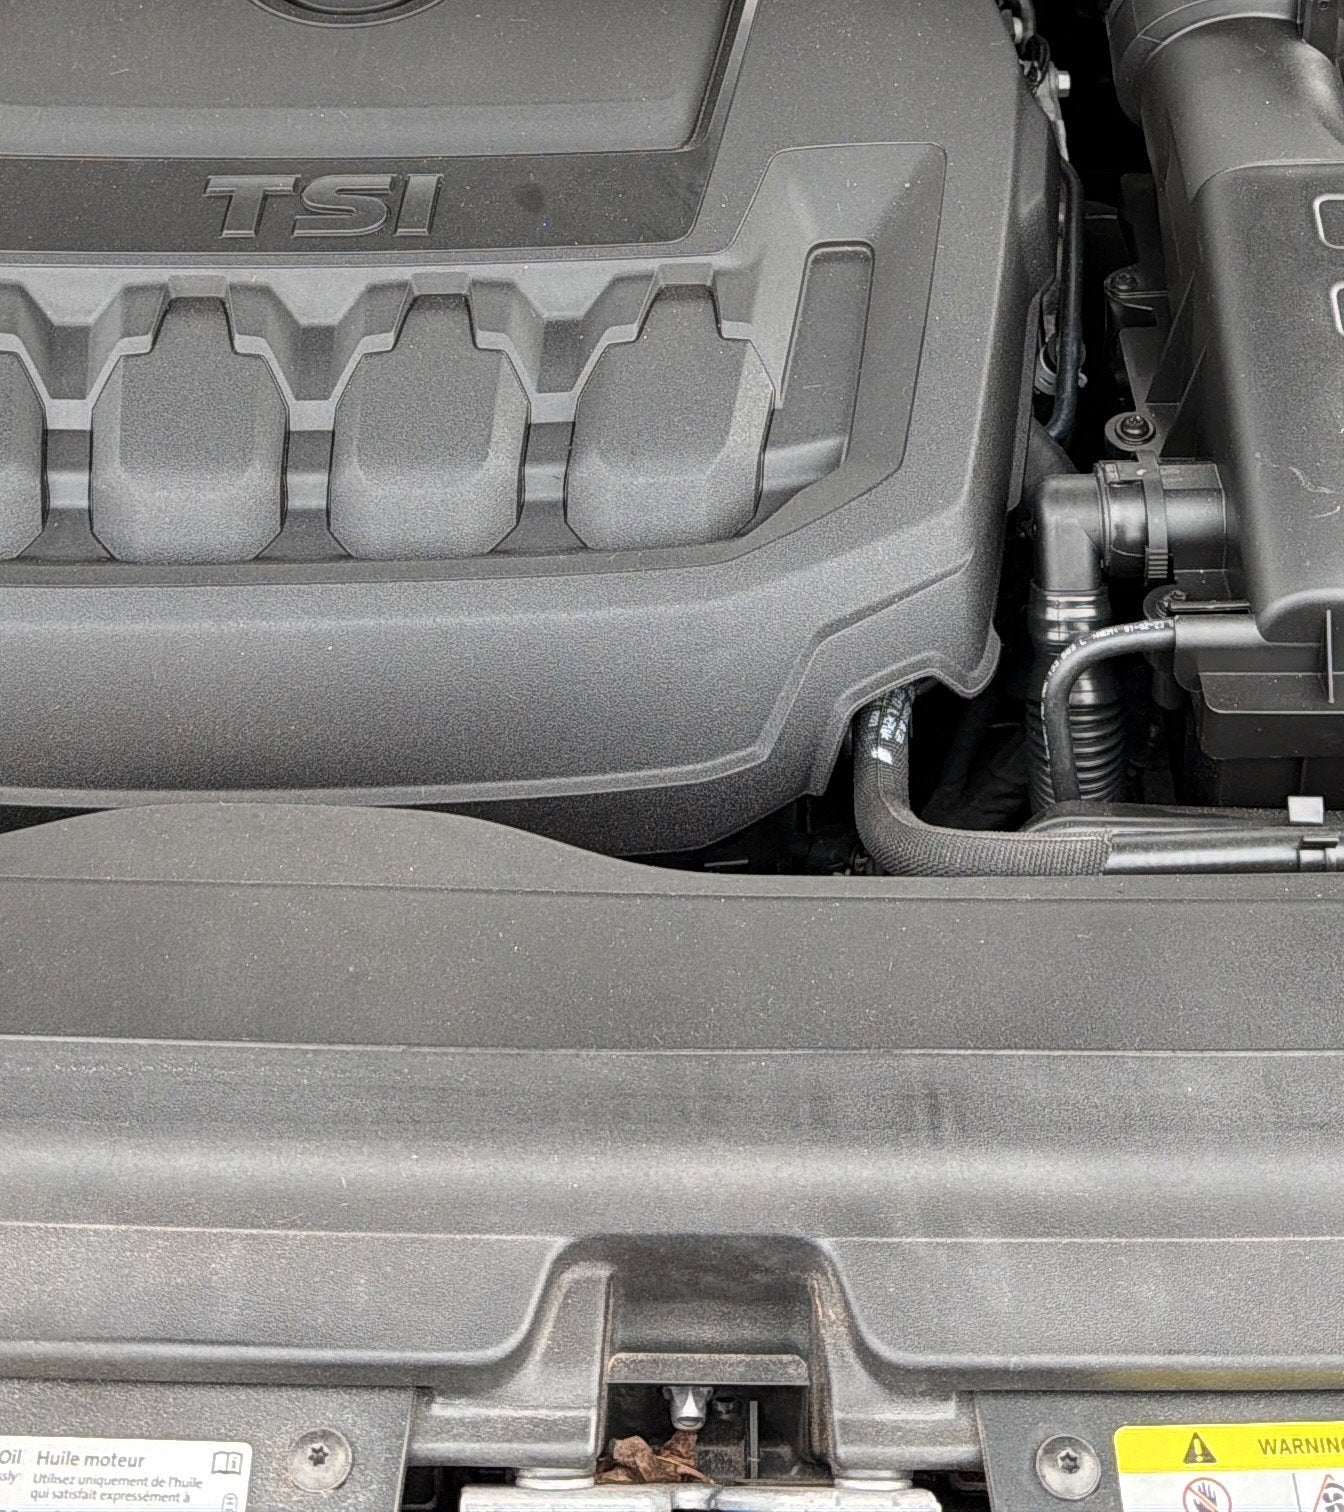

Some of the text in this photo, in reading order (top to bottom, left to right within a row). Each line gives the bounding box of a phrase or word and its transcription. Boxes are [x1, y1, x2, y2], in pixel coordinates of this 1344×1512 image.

[203, 173, 445, 238] TSI
[36, 1449, 80, 1467] Huile
[83, 1453, 146, 1469] moteur
[32, 1472, 75, 1486] Utilisez
[78, 1475, 149, 1488] uniquement
[151, 1476, 166, 1488] de
[30, 1489, 50, 1502] qui
[52, 1488, 97, 1500] satisfait
[182, 1492, 191, 1503] à
